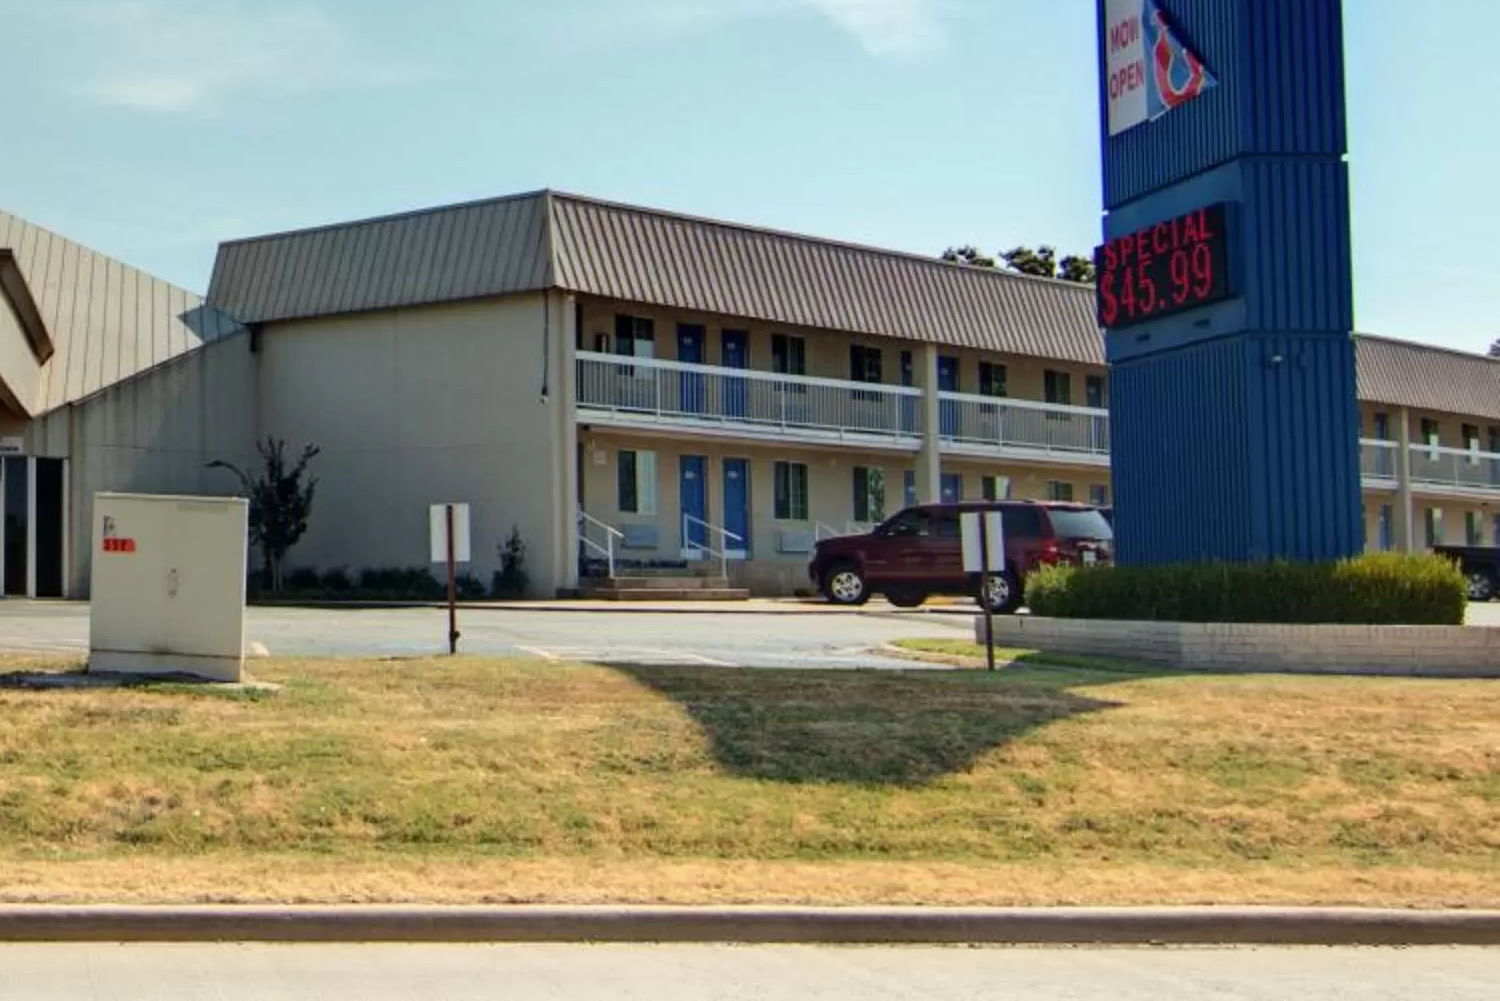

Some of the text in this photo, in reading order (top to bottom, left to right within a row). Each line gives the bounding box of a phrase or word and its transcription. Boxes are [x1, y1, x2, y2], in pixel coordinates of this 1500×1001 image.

[1110, 14, 1139, 55] NOW
[1109, 59, 1146, 101] OPEN
[1103, 207, 1213, 271] SPECIAL
[1100, 242, 1213, 326] $45.99
